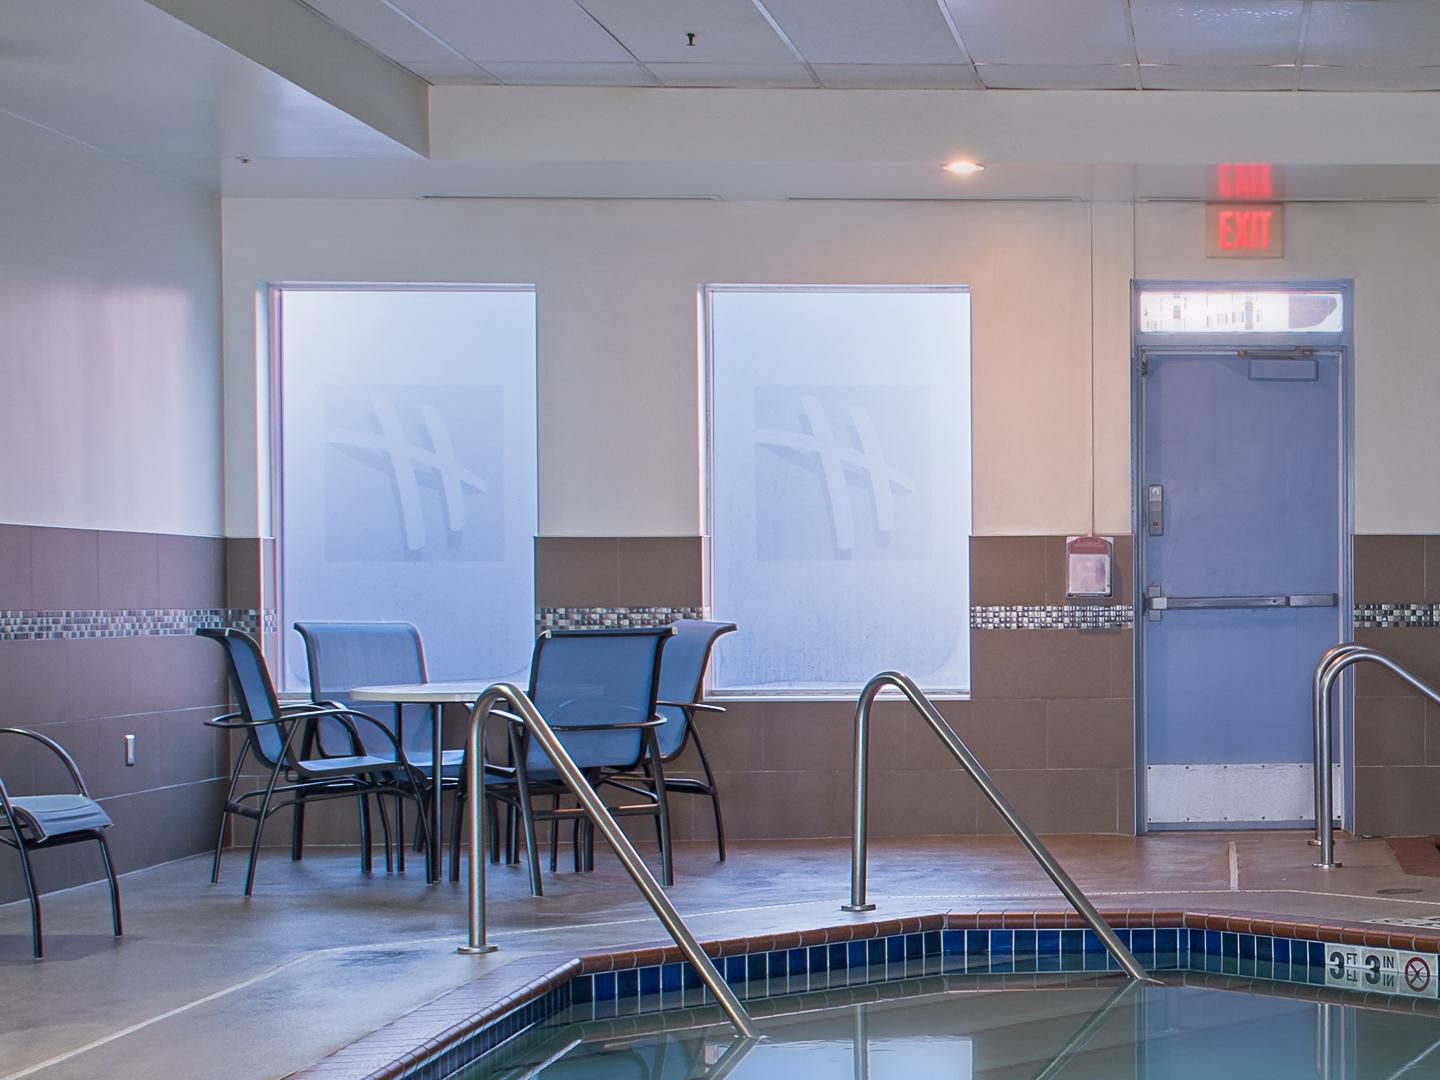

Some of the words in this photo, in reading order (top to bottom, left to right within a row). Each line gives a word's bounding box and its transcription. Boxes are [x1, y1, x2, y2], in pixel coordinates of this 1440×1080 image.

[1219, 211, 1272, 250] EXIT
[1347, 953, 1358, 965] FT
[1383, 956, 1394, 968] IN
